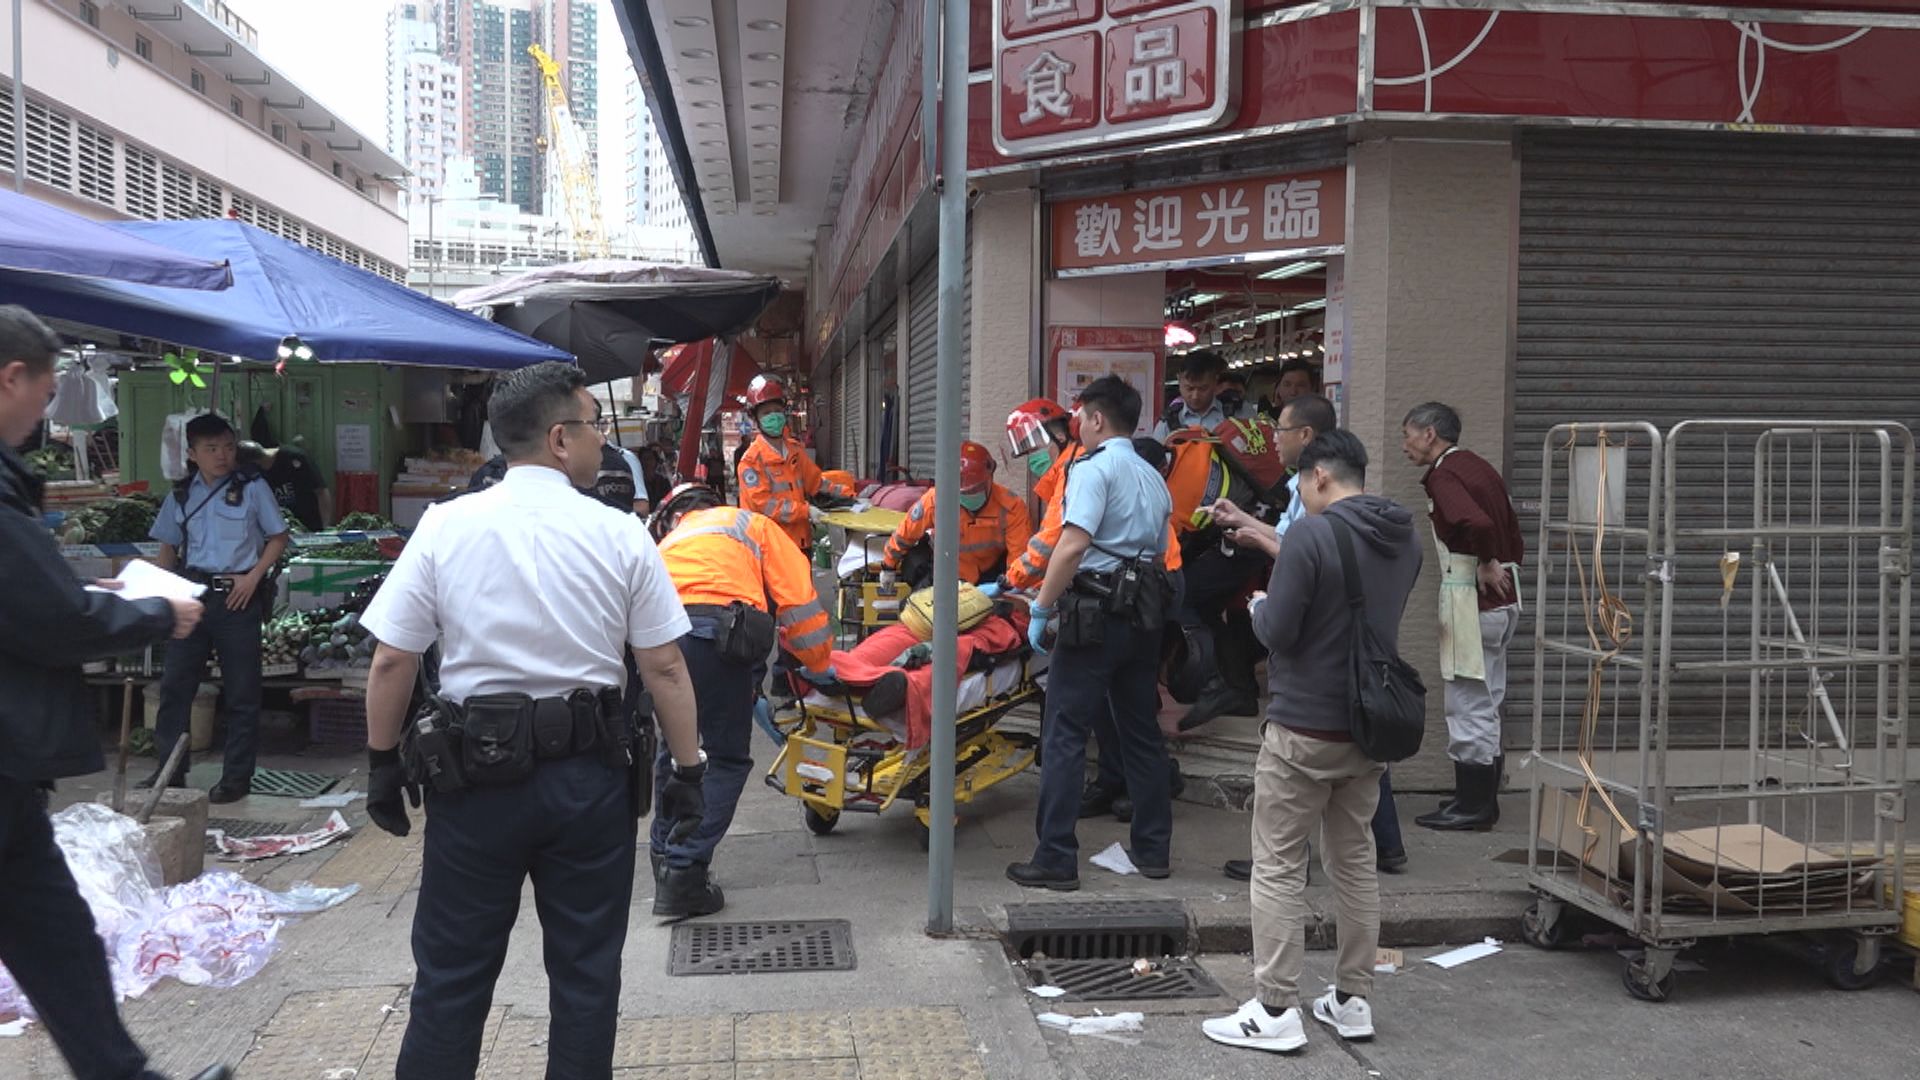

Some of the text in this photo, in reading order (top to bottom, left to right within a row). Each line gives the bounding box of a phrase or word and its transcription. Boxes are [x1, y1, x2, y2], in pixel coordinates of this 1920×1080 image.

[1020, 25, 1186, 125] 食品
[1075, 179, 1322, 257] 歡迎光臨
[1239, 1018, 1261, 1037] N
